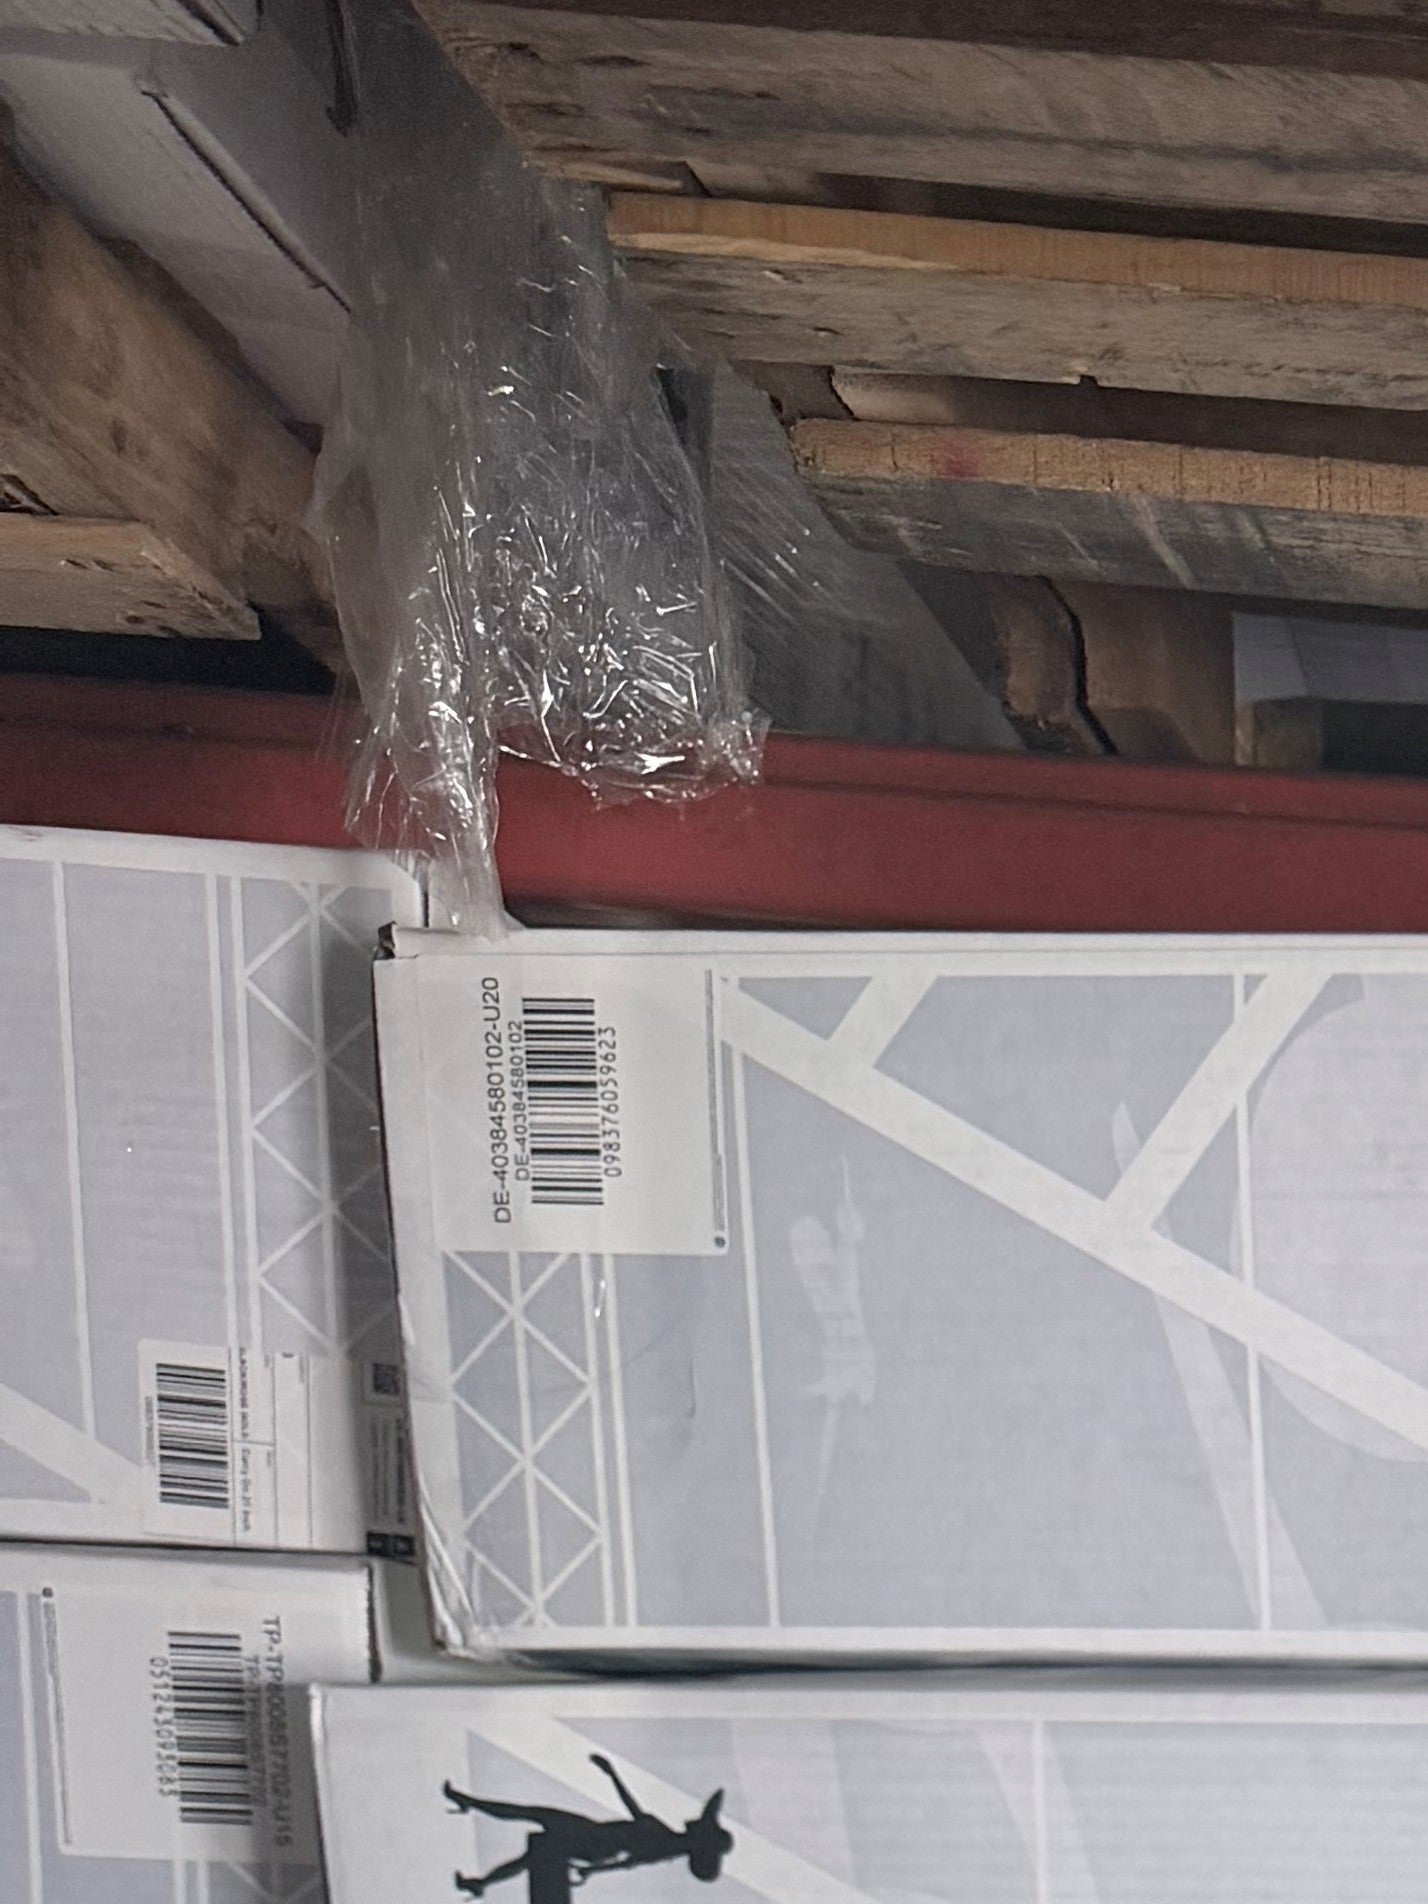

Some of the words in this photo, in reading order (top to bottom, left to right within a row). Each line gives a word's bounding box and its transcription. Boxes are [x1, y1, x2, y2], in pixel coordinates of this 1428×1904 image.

[482, 977, 511, 1224] DE-40384580102-U20
[508, 1021, 530, 1181] DE-40384580102
[599, 1026, 622, 1178] 098376059623
